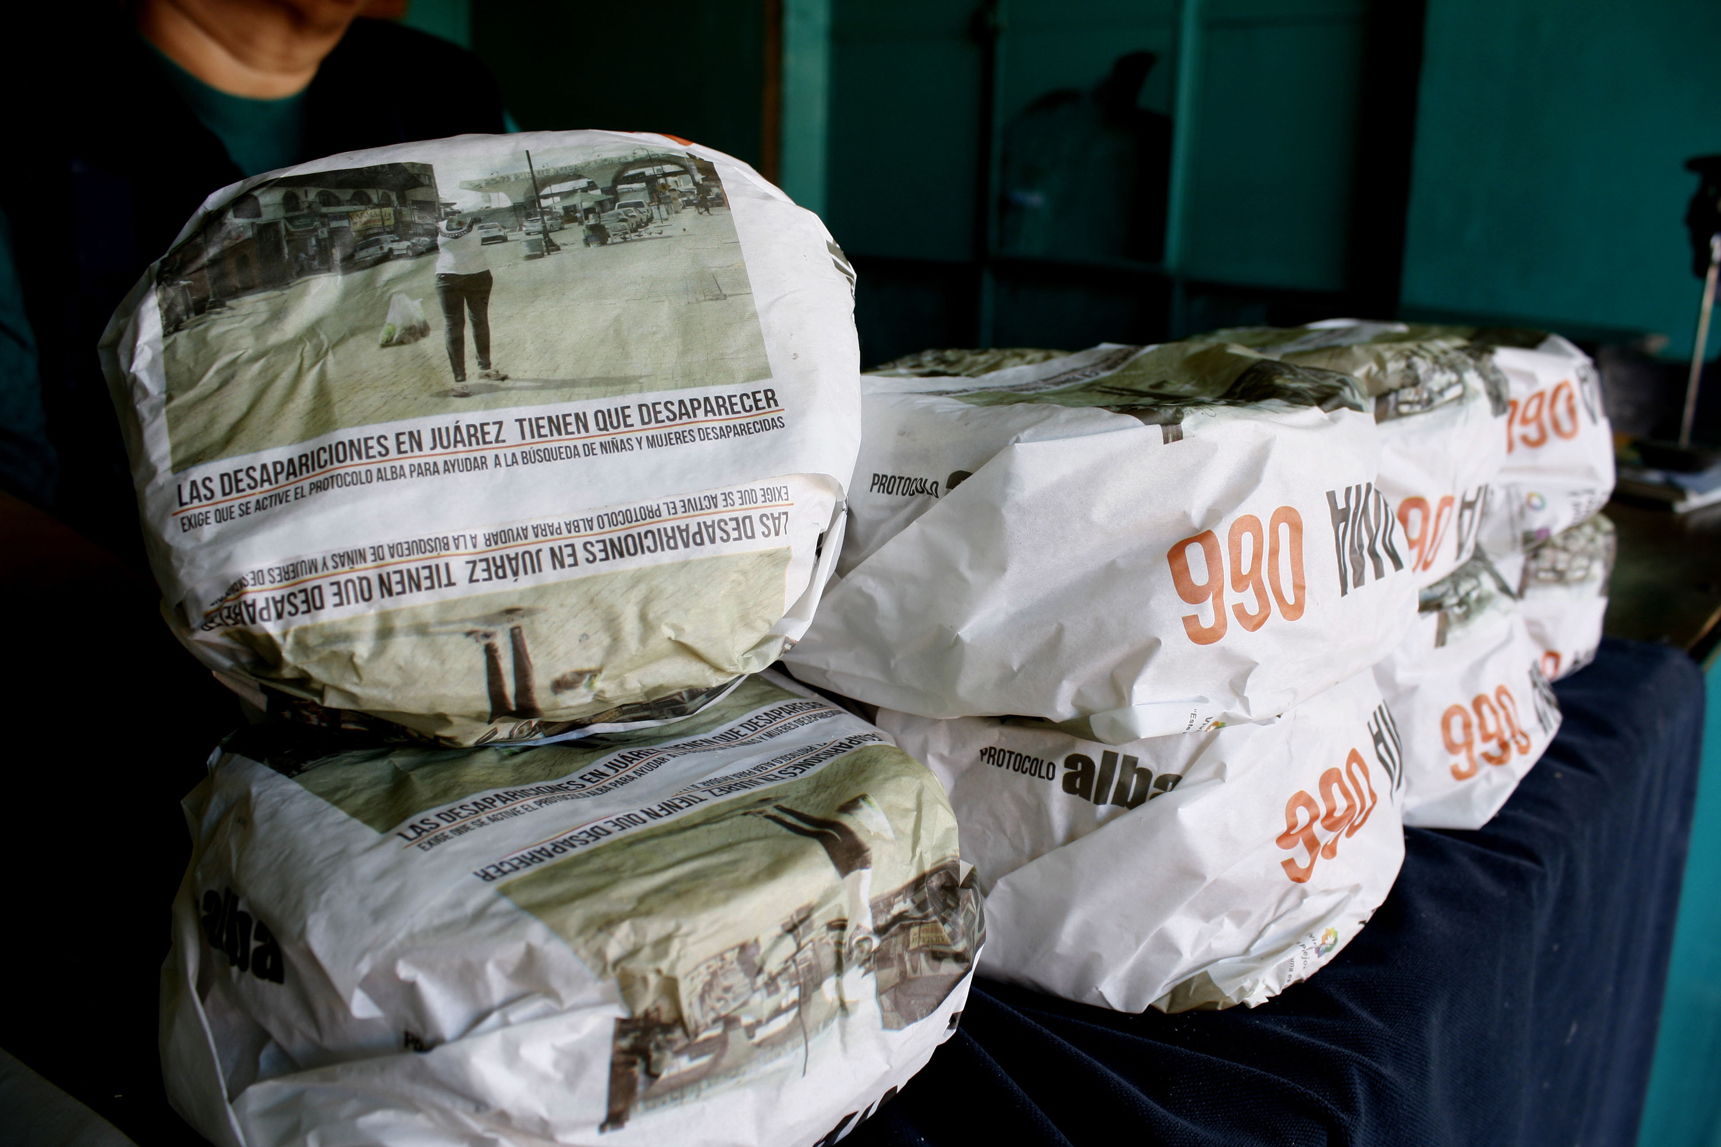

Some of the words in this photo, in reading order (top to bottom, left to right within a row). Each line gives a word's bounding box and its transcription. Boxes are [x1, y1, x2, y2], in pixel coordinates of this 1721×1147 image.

[177, 477, 214, 506] LAS
[220, 434, 390, 497] DESAPARICIONES
[395, 428, 423, 455] EN
[429, 420, 506, 450] JUÁREZ
[515, 410, 589, 441] TIENEN
[594, 405, 634, 433] QUE
[638, 388, 779, 425] DESAPARECER
[180, 507, 211, 532] EXIGE
[214, 502, 236, 525] QUE
[238, 500, 251, 517] SE
[254, 488, 292, 513] ACTIVE
[294, 485, 307, 501] EL
[309, 468, 373, 498] PROTOCOLO
[376, 464, 406, 483] ALBA
[409, 459, 440, 477] PARA
[443, 454, 489, 475] AYUDAR
[494, 454, 502, 469] A
[505, 452, 519, 468] LA
[521, 444, 581, 465] BÚSQUEDA
[583, 442, 597, 457] DE
[600, 437, 634, 455] NIÑAS
[636, 436, 644, 450] Y
[646, 428, 696, 449] MUJERES
[699, 416, 785, 442] DESAPARECIDAS
[681, 492, 717, 513] ACTIVE
[722, 491, 735, 506] SE
[738, 488, 758, 505] QUE
[762, 486, 789, 501] EXIGE
[597, 504, 661, 529] PROTOCOLO
[662, 503, 678, 516] EL
[532, 523, 562, 541] PARA
[565, 516, 593, 535] ALBA
[762, 511, 789, 537] LAS
[388, 536, 450, 558] BÚSQUEDA
[452, 535, 467, 549] LA
[469, 534, 477, 547] A
[484, 528, 529, 548] AYUDAR
[585, 514, 755, 564] DESAPARICIONES
[321, 557, 329, 572] Y
[331, 547, 367, 570] NIÑAS
[370, 546, 385, 560] DE
[549, 542, 578, 571] EN
[269, 559, 318, 584] MUJERES
[464, 548, 543, 585] JUÁREZ
[332, 576, 371, 607] QUE
[379, 562, 456, 598] TIENEN
[979, 746, 1056, 782] PROTOCOLO
[397, 817, 440, 842] LAS
[435, 779, 586, 823] DESAPARICIONES
[578, 768, 610, 786] EN
[712, 728, 748, 745] QUE
[520, 804, 539, 815] EL
[611, 774, 638, 789] PARA
[633, 757, 671, 778] AYUDAR
[604, 813, 647, 830] QUE
[473, 825, 615, 883] DESAPARECER
[202, 887, 285, 985] alba
